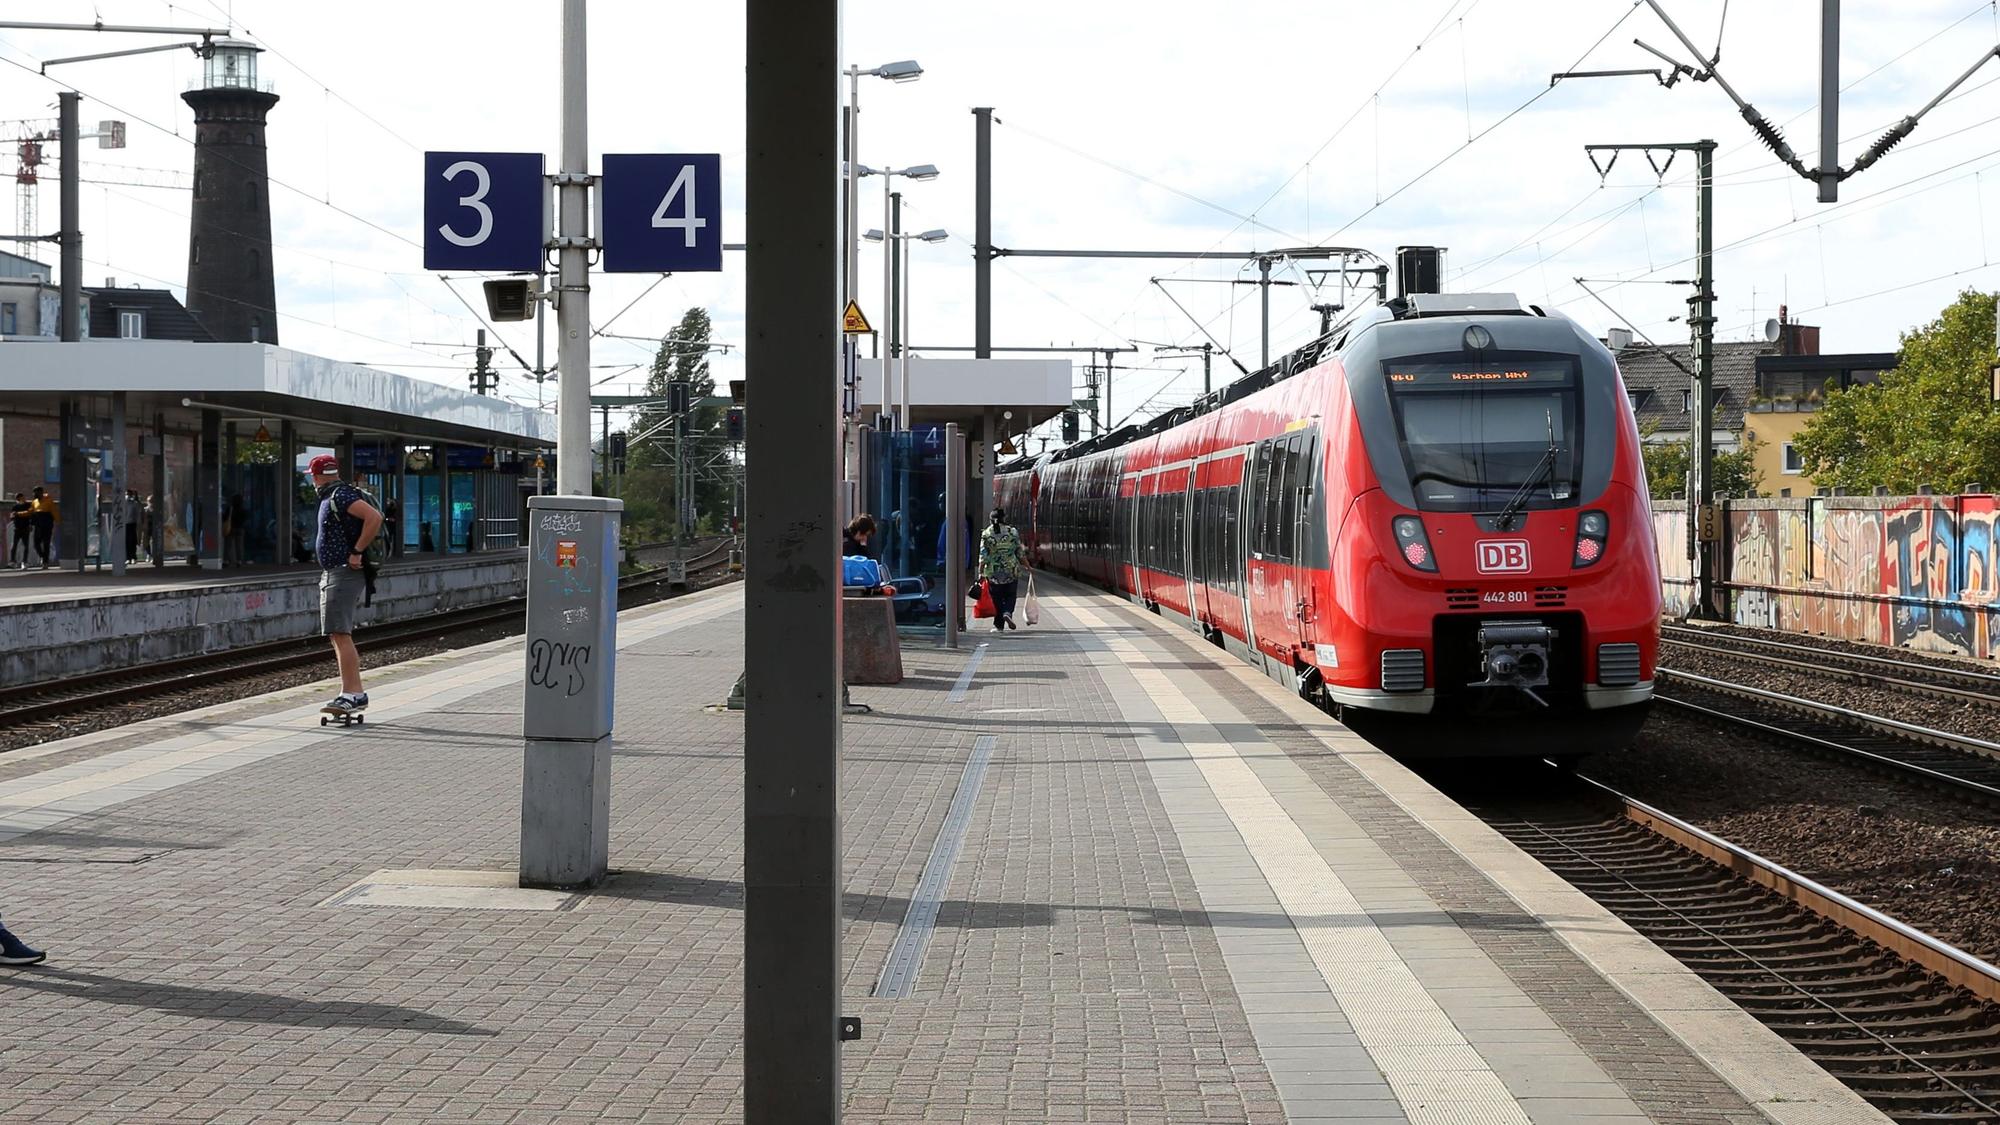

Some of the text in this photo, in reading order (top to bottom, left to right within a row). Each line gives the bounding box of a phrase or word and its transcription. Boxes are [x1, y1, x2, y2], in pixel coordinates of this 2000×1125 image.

[438, 160, 494, 247] 3
[651, 164, 707, 248] 4
[924, 426, 940, 449] 4
[1704, 506, 1714, 521] 3
[1704, 522, 1714, 538] 8
[1482, 545, 1524, 568] DB
[1483, 591, 1528, 603] 442 801
